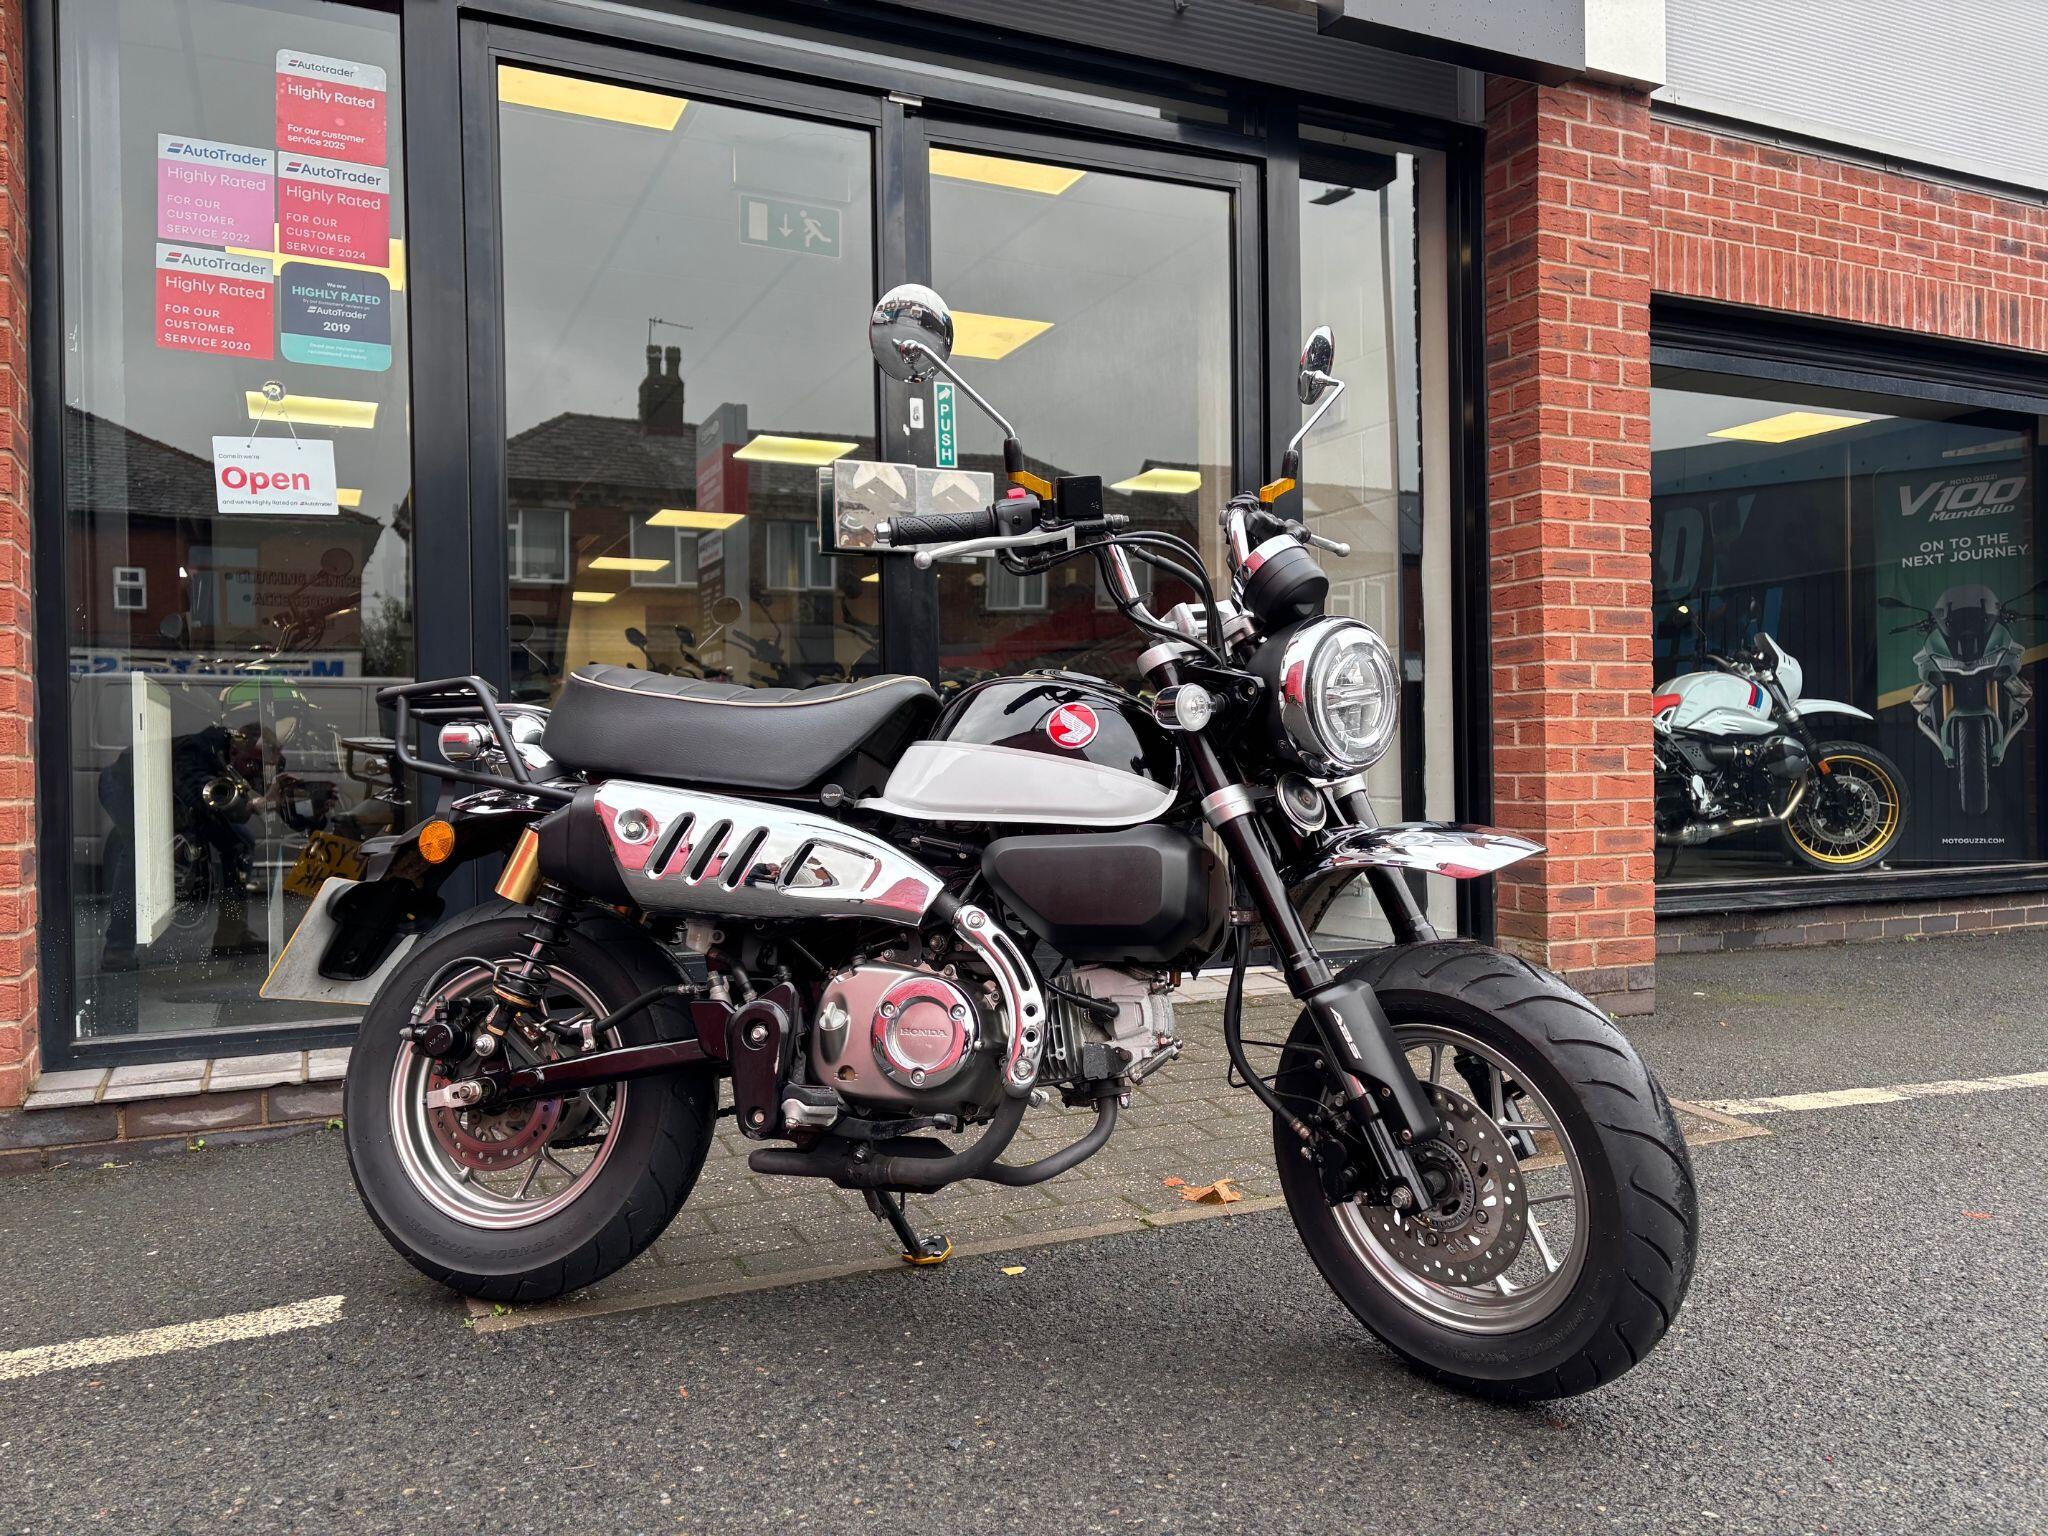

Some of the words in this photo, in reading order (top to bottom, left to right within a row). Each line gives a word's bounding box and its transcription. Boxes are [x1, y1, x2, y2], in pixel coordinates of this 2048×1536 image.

[297, 61, 354, 77] Autotrader
[288, 84, 332, 103] Highly
[334, 92, 375, 109] Rated
[287, 124, 302, 133] For
[304, 128, 320, 136] our
[321, 130, 365, 143] customer
[287, 134, 321, 146] service
[322, 140, 346, 150] 2025
[183, 144, 267, 167] AutoTrader
[167, 166, 217, 186] Highly
[220, 174, 266, 191] Rated
[301, 164, 381, 186] AutoTrader
[167, 195, 191, 206] FOR
[195, 199, 221, 209] OUR
[286, 185, 333, 205] Highly
[337, 193, 381, 210] Rated
[166, 209, 235, 226] CUSTOMER
[286, 212, 309, 223] FOR
[313, 217, 337, 227] OUR
[166, 224, 217, 238] SERVICE
[222, 232, 250, 243] 2022
[286, 227, 351, 243] CUSTOMER
[286, 242, 335, 256] SERVICE
[338, 249, 366, 260] 2024
[181, 254, 266, 275] AutoTrader
[165, 276, 215, 295] Highly
[219, 283, 265, 300] Rated
[292, 285, 338, 300] HIGHLY
[341, 292, 381, 305] RATED
[165, 304, 190, 314] FOR
[193, 307, 220, 319] OUR
[316, 307, 367, 320] AutoTrader
[165, 318, 235, 335] CUSTOMER
[323, 321, 351, 333] 2019
[164, 333, 218, 347] SERVICE
[220, 340, 251, 351] 2020
[940, 404, 952, 461] PUSH
[221, 466, 311, 495] Open
[1950, 476, 1972, 486] MOTO
[1973, 473, 1998, 482] GUZZI
[252, 499, 271, 507] Highly
[1899, 476, 2027, 516] V100
[1928, 503, 2015, 522] Mandello
[1920, 540, 1944, 553] ON
[1949, 537, 1972, 549] TO
[1977, 532, 2009, 546] THE
[1902, 553, 1944, 568] NEXT
[1950, 544, 2029, 563] JOURNEY
[899, 1027, 948, 1038] HONDA
[1329, 1006, 1363, 1059] ABS
